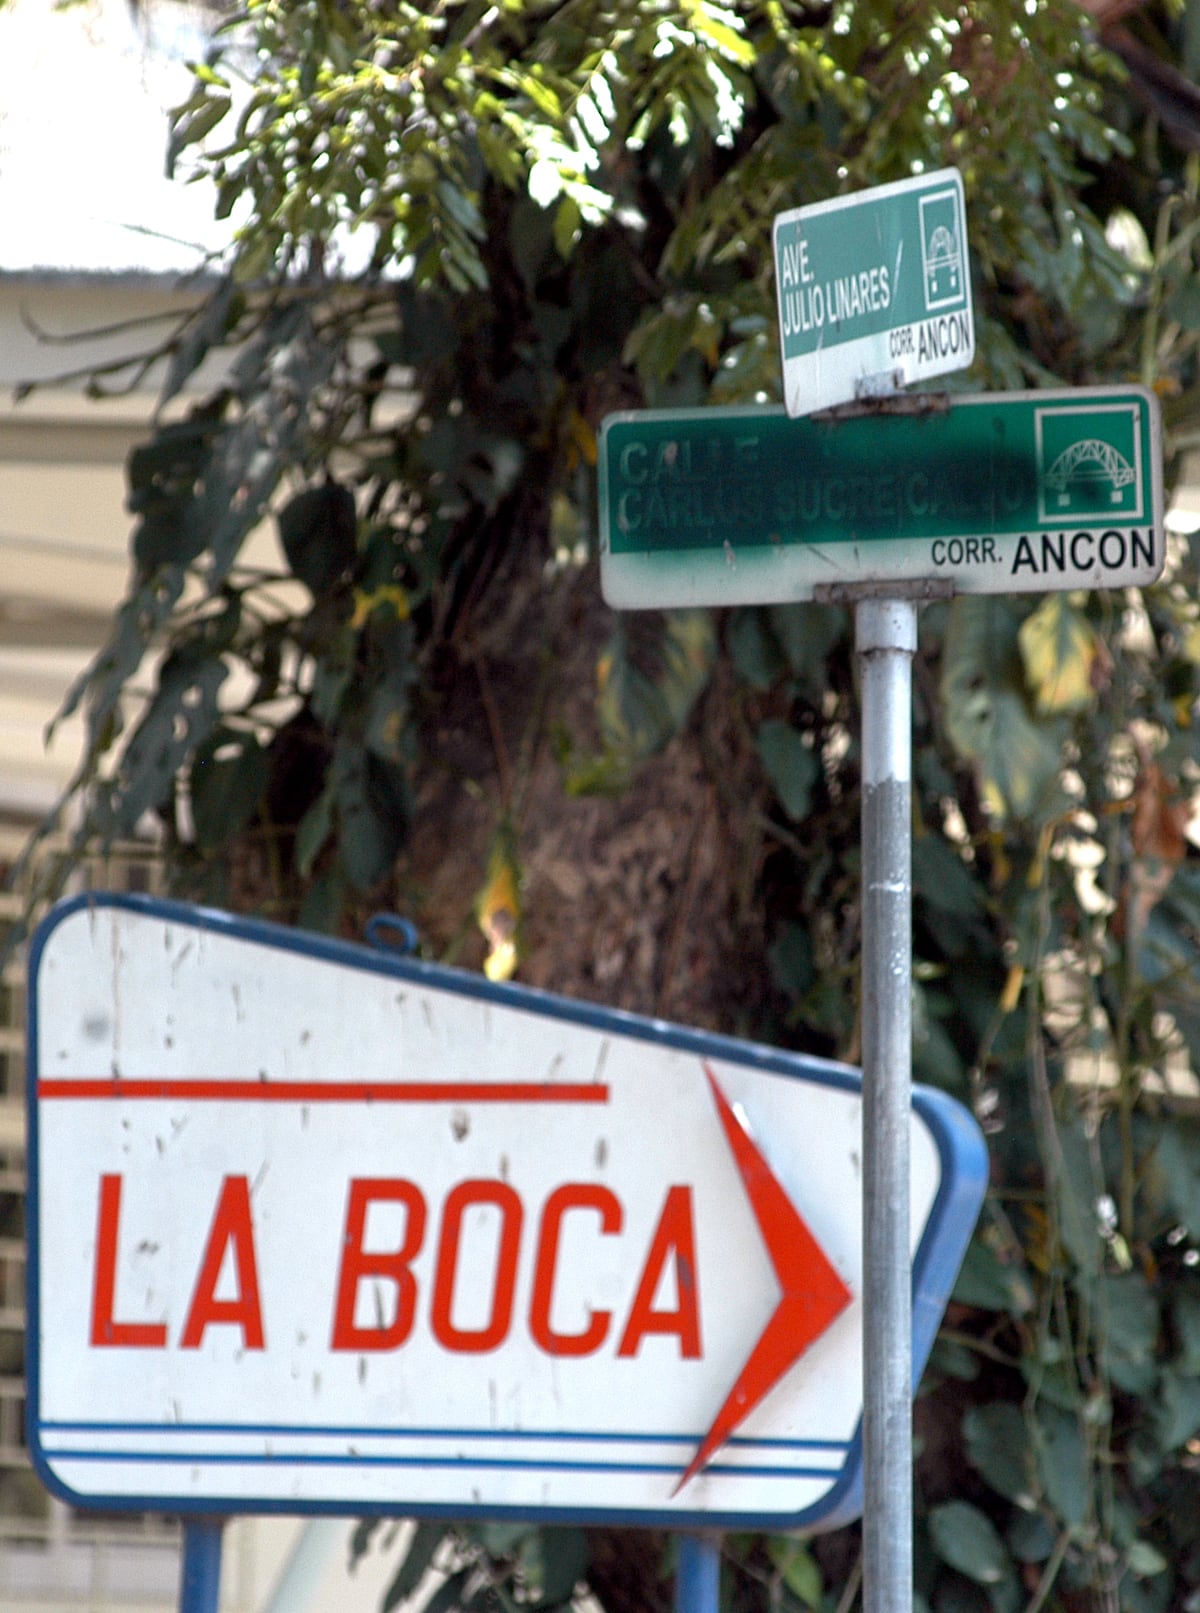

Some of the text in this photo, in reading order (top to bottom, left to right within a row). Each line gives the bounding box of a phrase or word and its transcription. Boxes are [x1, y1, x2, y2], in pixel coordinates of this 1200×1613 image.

[782, 240, 814, 288] AVE.
[784, 265, 890, 337] JULIO LINARES
[889, 309, 971, 363] CORR. ANCON
[619, 436, 761, 486] CALLE
[773, 474, 896, 522] SUCRE
[931, 528, 1156, 575] CORR. ANCON
[89, 1173, 703, 1358] LA BOCA
